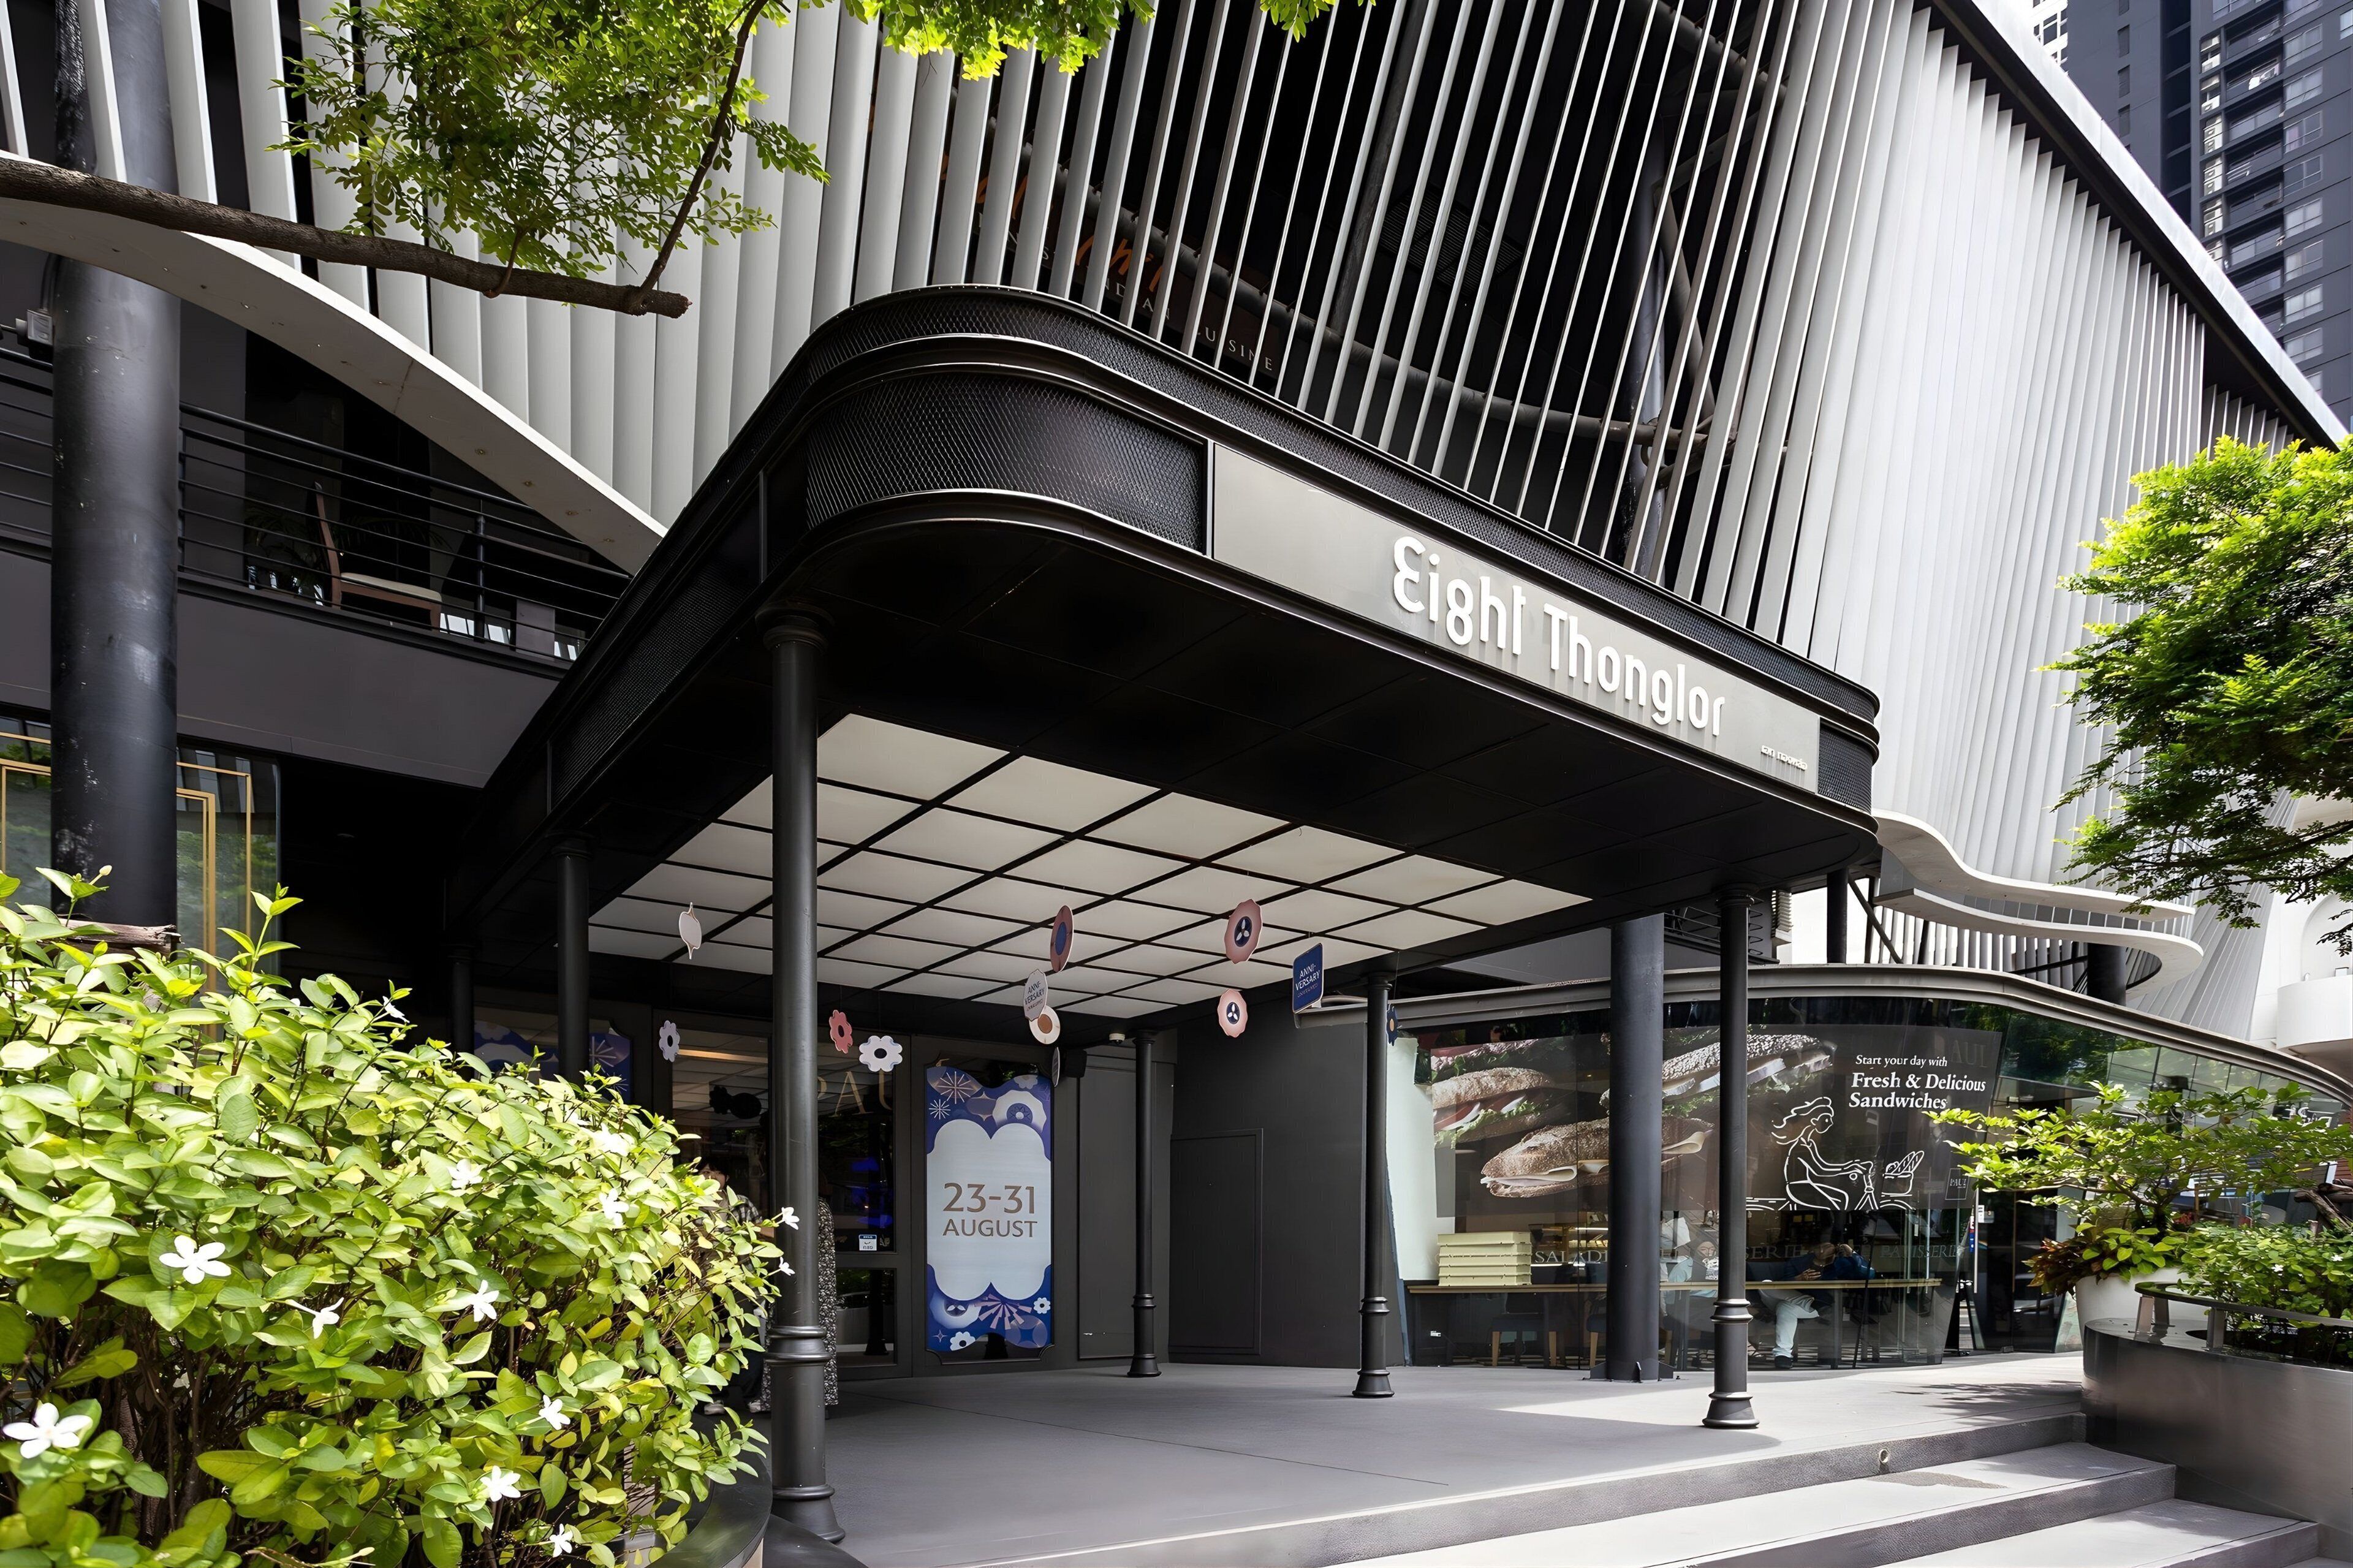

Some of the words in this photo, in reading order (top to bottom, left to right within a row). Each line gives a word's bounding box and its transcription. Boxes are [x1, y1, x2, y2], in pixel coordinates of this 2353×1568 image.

[1544, 603, 1726, 737] Thonglor
[1295, 970, 1320, 991] VERSARY
[1855, 1055, 1882, 1064] Start
[1884, 1057, 1908, 1068] your
[1910, 1055, 1926, 1069] day
[1928, 1056, 1947, 1067] with
[1851, 1072, 1900, 1088] Fresh
[1906, 1074, 1922, 1089] &
[1925, 1074, 1986, 1092] Delicious
[1849, 1091, 1947, 1110] Sandwiches
[942, 1182, 1035, 1214] 23-31
[942, 1218, 1038, 1238] AUGUST
